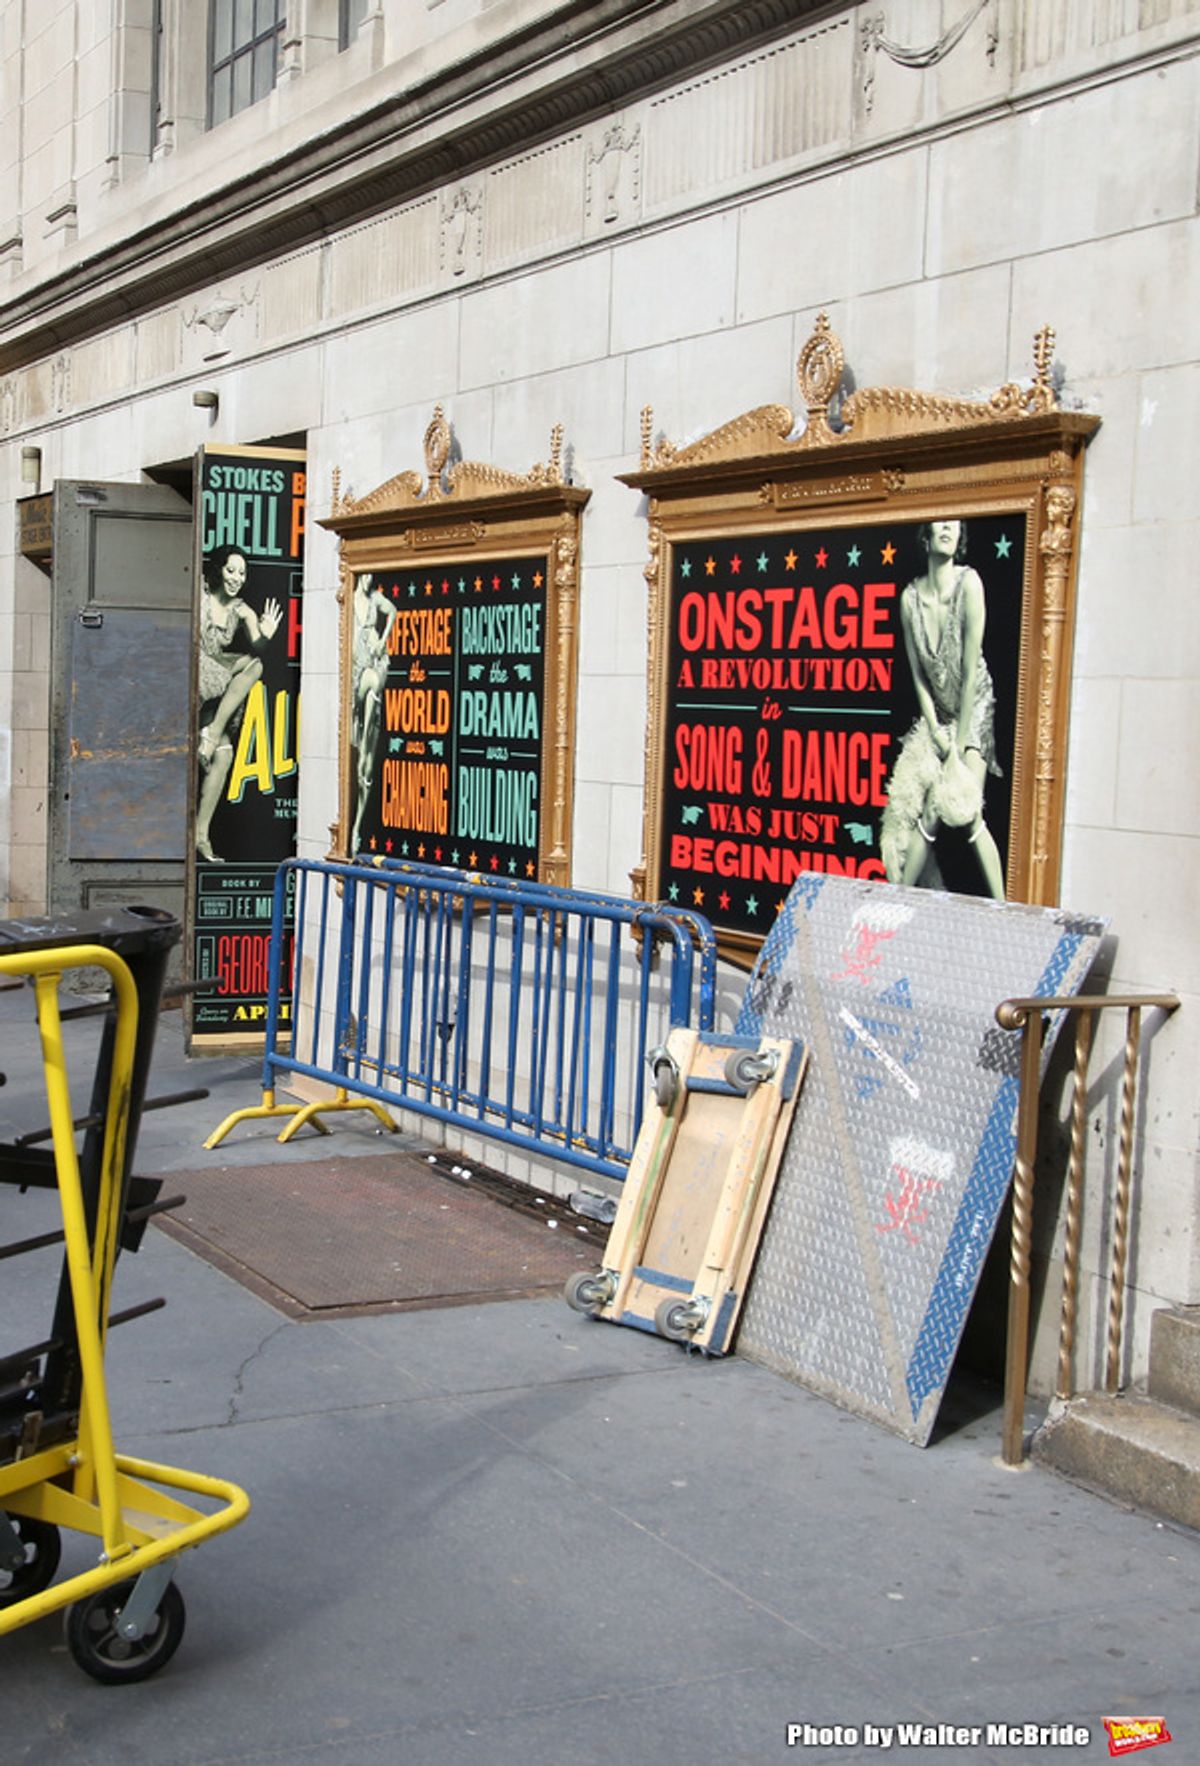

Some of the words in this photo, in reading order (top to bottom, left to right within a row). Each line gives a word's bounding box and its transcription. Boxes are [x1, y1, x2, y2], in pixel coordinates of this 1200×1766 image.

[209, 465, 285, 493] STOKES
[202, 490, 282, 556] CHELL
[462, 603, 541, 655] BACKSTAGE
[678, 583, 896, 651] ONSTAGE
[409, 660, 426, 682] the
[489, 660, 509, 683] the
[677, 659, 695, 688] A
[701, 658, 893, 691] REVOLUTION
[385, 688, 450, 734] WORLD
[460, 690, 539, 739] DRAMA
[761, 696, 782, 720] in
[227, 680, 301, 803] AL
[674, 723, 743, 794] SONG
[752, 728, 772, 797] &
[782, 729, 891, 807] DANCE
[382, 758, 448, 835] CHANGING
[458, 765, 538, 848] BUILDING
[707, 802, 762, 836] WAS
[767, 808, 839, 845] JUST
[222, 880, 246, 888] BOOK
[248, 880, 261, 888] BY
[256, 897, 294, 918] MIE
[218, 935, 286, 994] GEOR
[233, 1004, 292, 1020] API
